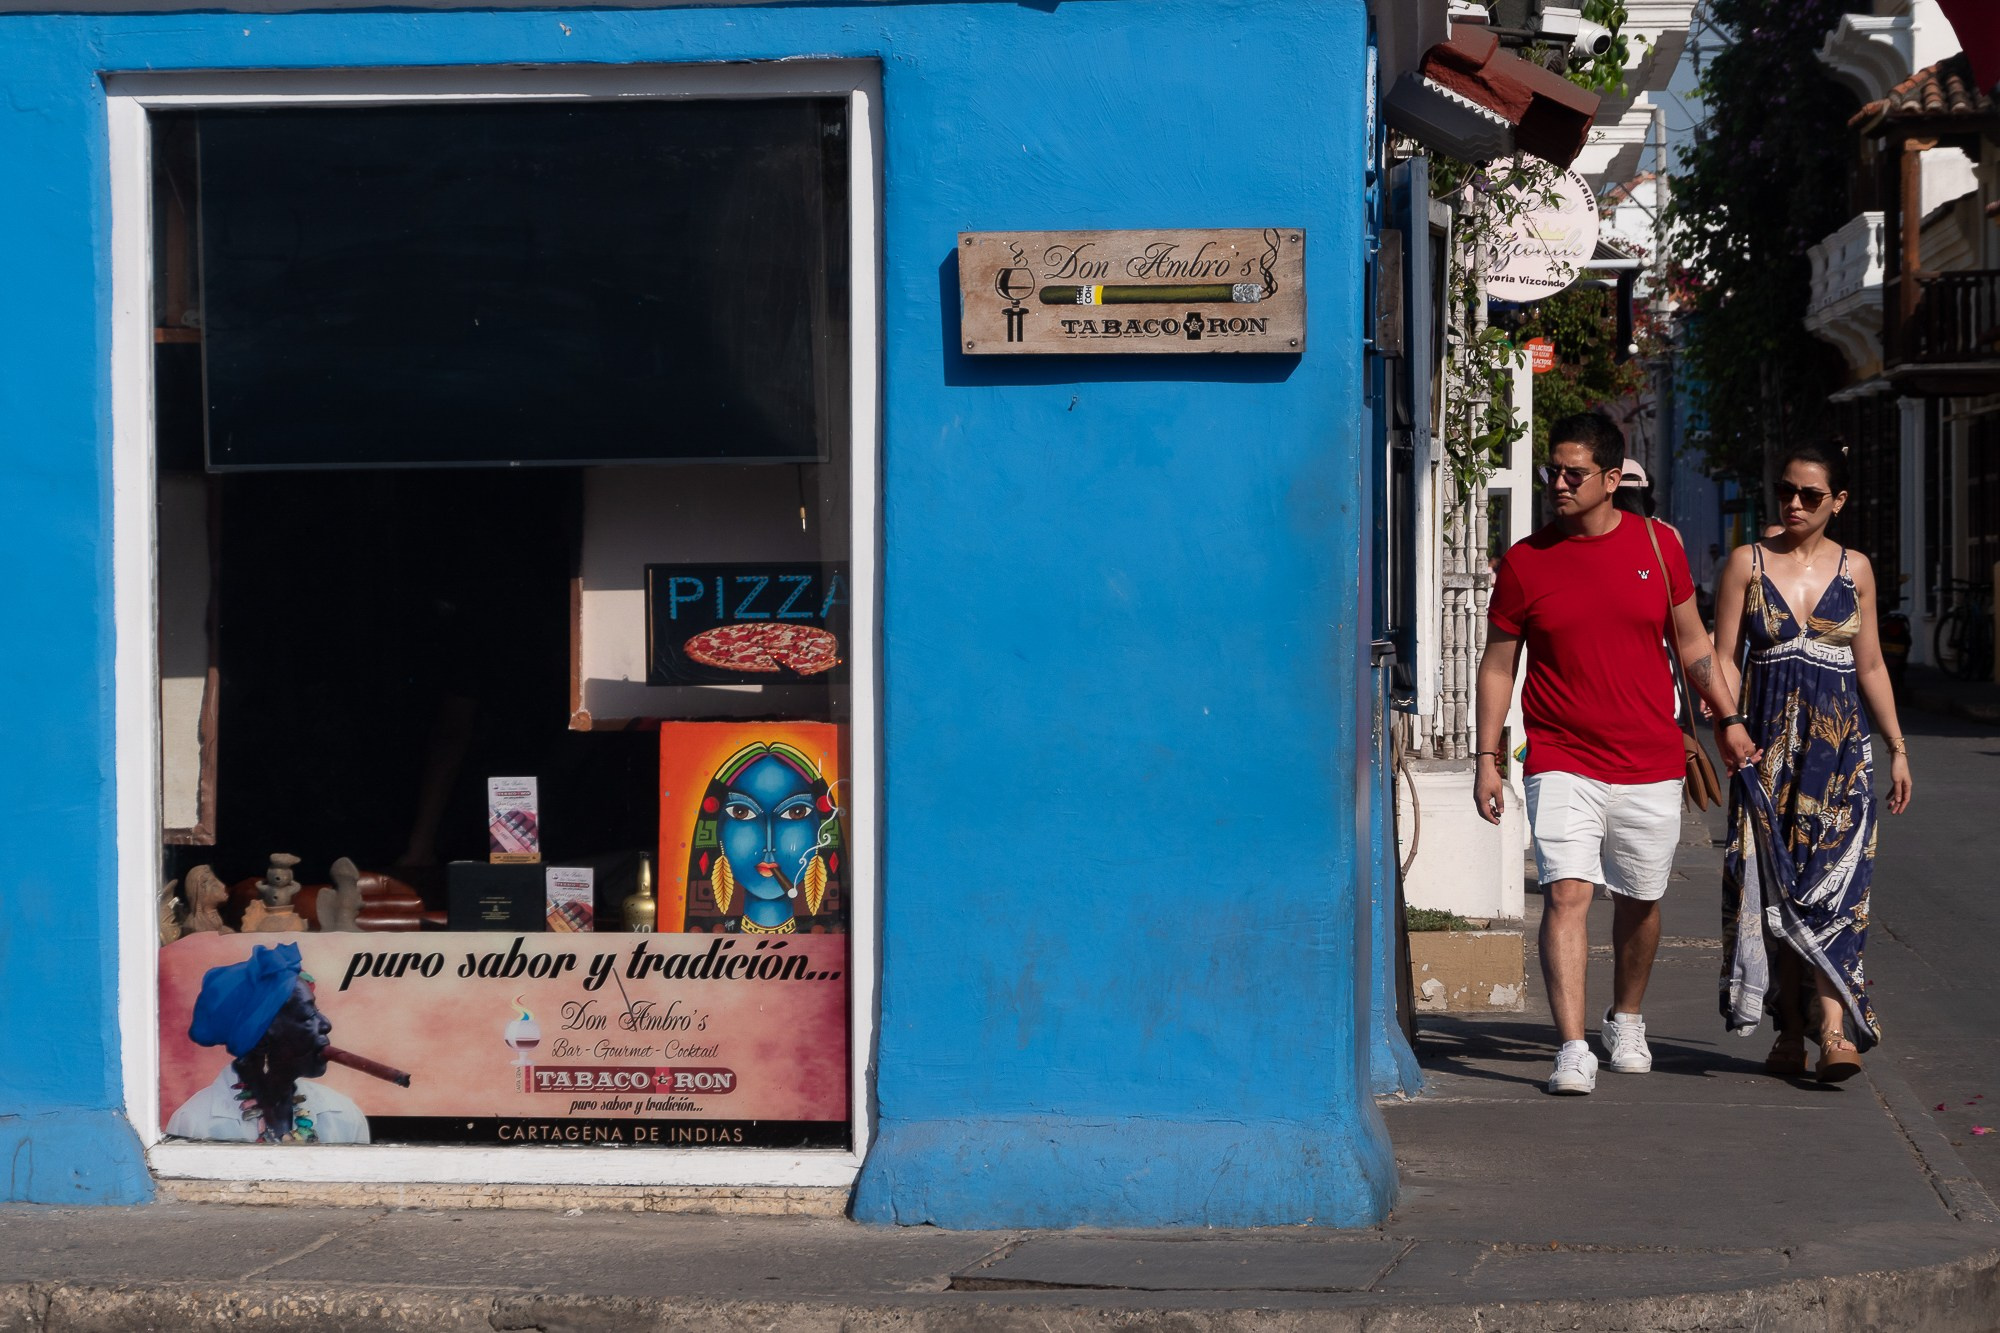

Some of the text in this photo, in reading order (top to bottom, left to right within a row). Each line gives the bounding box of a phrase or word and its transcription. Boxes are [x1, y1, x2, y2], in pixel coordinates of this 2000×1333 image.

[1566, 169, 1594, 212] meralds
[1043, 241, 1256, 279] Don Ambro's
[1487, 273, 1566, 288] yeria Vizconde
[1060, 317, 1179, 338] TABACO
[1208, 317, 1270, 337] RON
[668, 574, 848, 620] PIZZA
[338, 951, 445, 992] puro
[457, 936, 579, 979] sabor
[582, 952, 617, 992] y
[560, 999, 709, 1032] Don Ambro's
[551, 1037, 583, 1058] Bar
[593, 1038, 653, 1060] Gourmet
[664, 1038, 719, 1059] Cocktail
[535, 1071, 651, 1091] TABACO
[674, 1072, 733, 1092] RON
[569, 1099, 597, 1115] puro
[600, 1096, 632, 1112] sabor
[634, 1100, 642, 1115] y
[497, 1125, 744, 1143] CARTAGENA DE INDIAS
